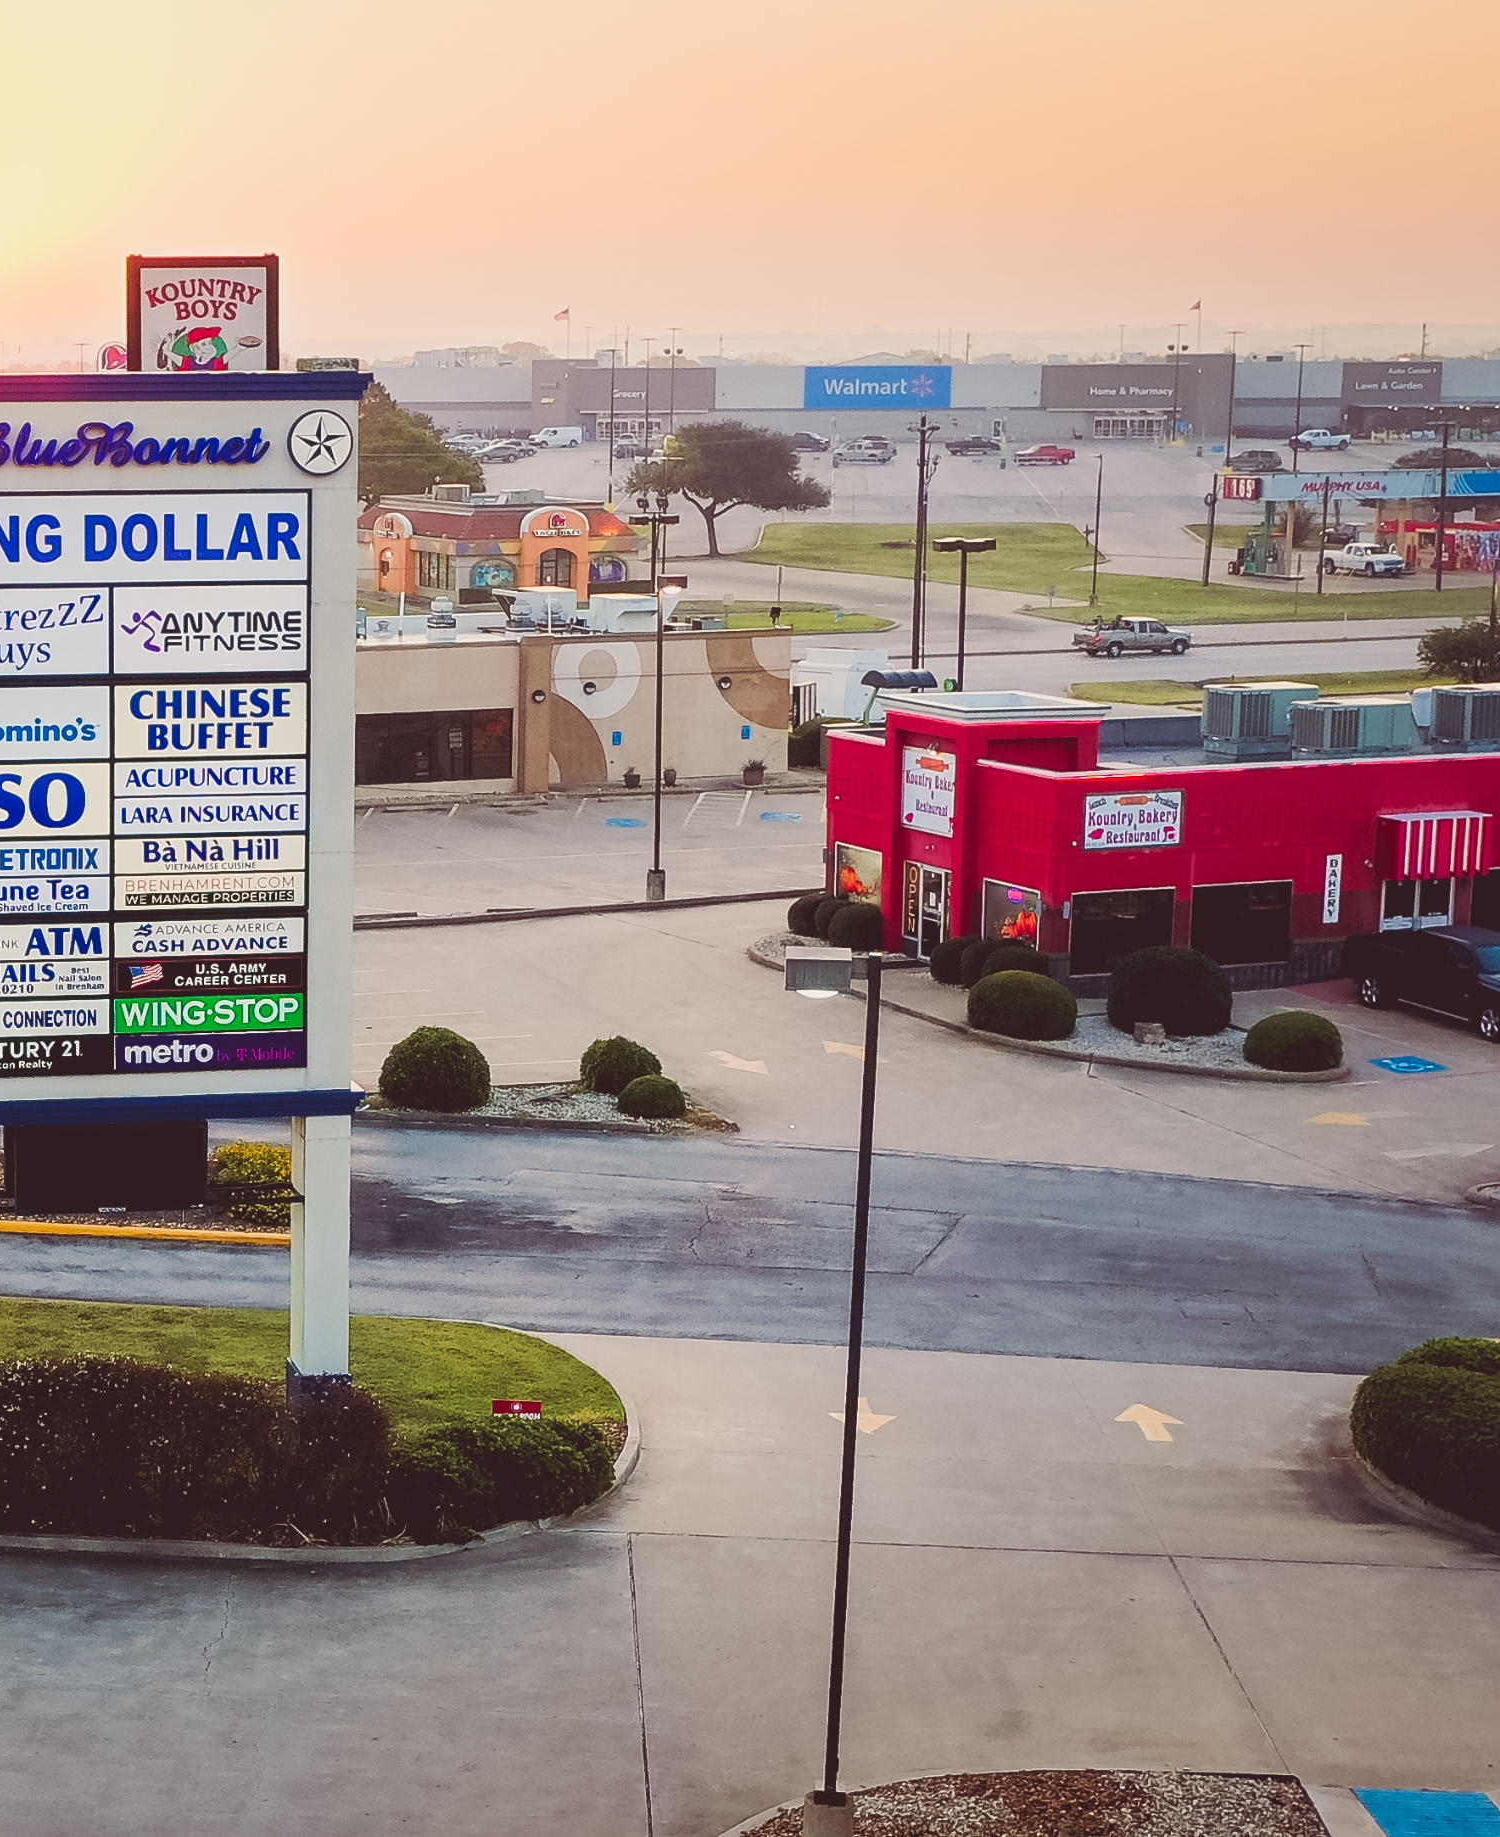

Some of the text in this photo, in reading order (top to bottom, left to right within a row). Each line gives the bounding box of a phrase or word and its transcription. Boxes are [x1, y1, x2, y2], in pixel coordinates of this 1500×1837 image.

[145, 278, 263, 308] KOUNTRY
[174, 299, 238, 321] BOYS
[612, 388, 646, 400] Grocery
[823, 378, 908, 395] Walmart
[1089, 385, 1174, 397] Home & Pharmacy
[1355, 380, 1423, 390] Lawn & Garden
[1355, 481, 1381, 491] USA
[84, 512, 302, 562] DOLLAR
[160, 610, 302, 634] ANYTIME
[164, 634, 302, 652] FITNESS
[129, 688, 291, 719] CHINESE
[147, 722, 274, 750] BUFFET
[125, 766, 297, 788] ACUPUNCTURE
[906, 770, 932, 790] Kountry
[121, 804, 300, 824] LARA INSURANCE
[915, 799, 948, 816] Restaurant
[1088, 808, 1178, 827] Kountry Bakery
[1106, 828, 1161, 844] Restaurant
[142, 838, 279, 863] Bà Nà Hill
[164, 862, 257, 871] VIETNAMESE CUISINE
[46, 879, 90, 901] Tea
[125, 876, 295, 892] BRENHAMRENT.COM
[1327, 858, 1339, 918] BAKERY
[37, 902, 52, 911] Ice
[55, 902, 88, 911] Cream
[126, 891, 294, 905] WE MANAGE PROPERTIES
[907, 866, 918, 933] OPEN
[155, 922, 286, 935] ADVANCE AMERICA
[24, 927, 103, 956] ATM
[132, 936, 288, 953] CASH ADVANCE
[195, 963, 266, 974] U.S. ARMY
[78, 974, 102, 982] Salon
[174, 974, 287, 986] CAREER CENTER
[2, 1009, 97, 1029] CONNECTION
[124, 1040, 214, 1064] metro
[216, 1048, 232, 1066] by
[250, 1046, 295, 1061] Mobile
[18, 1060, 53, 1070] Realty
